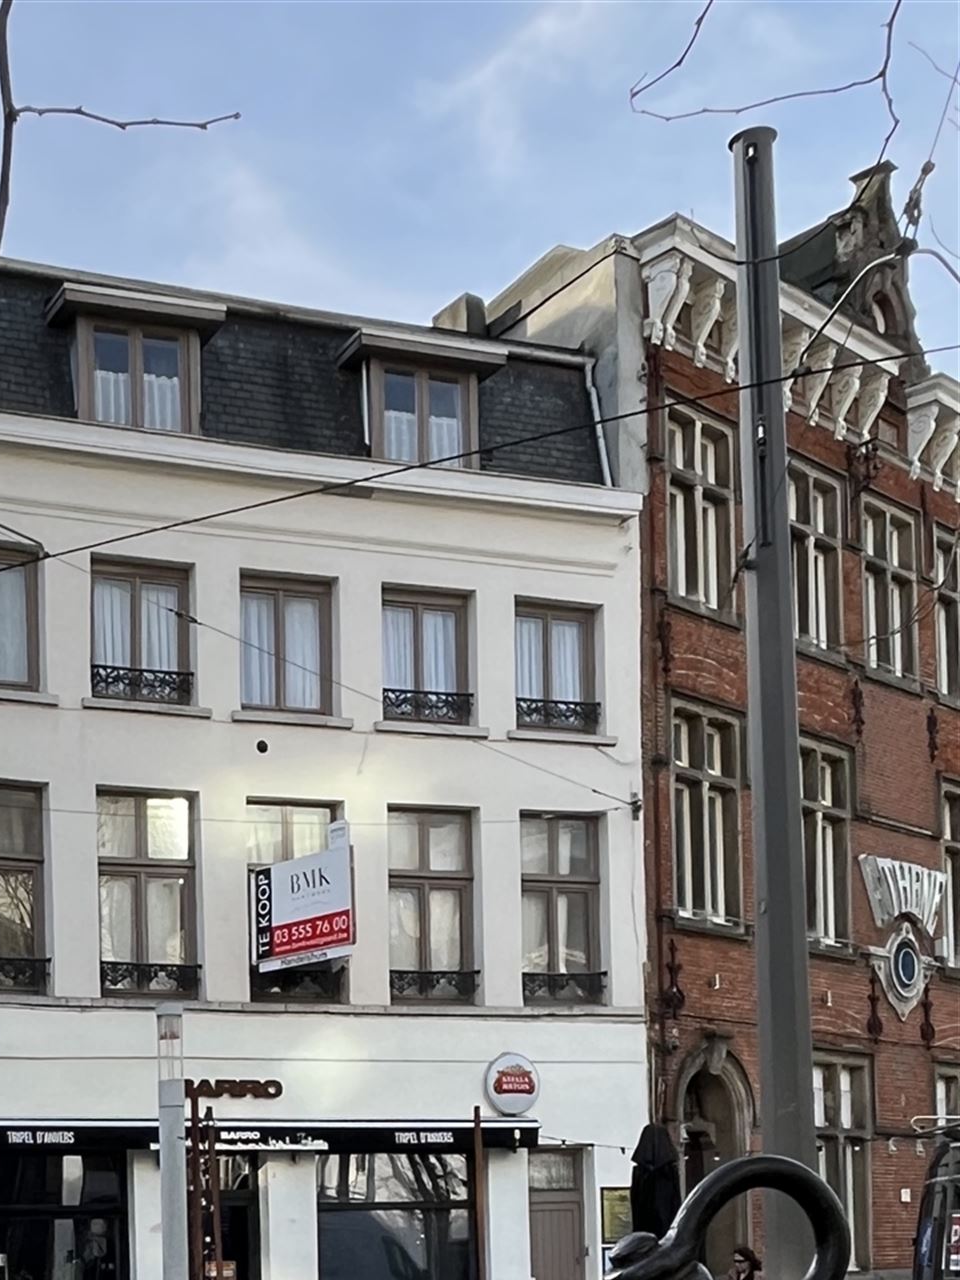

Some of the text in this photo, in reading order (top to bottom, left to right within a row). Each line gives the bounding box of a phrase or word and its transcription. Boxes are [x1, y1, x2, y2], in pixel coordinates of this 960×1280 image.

[290, 868, 331, 894] BMK
[258, 874, 270, 955] TE KOOP
[273, 915, 348, 944] 03 555 76 00
